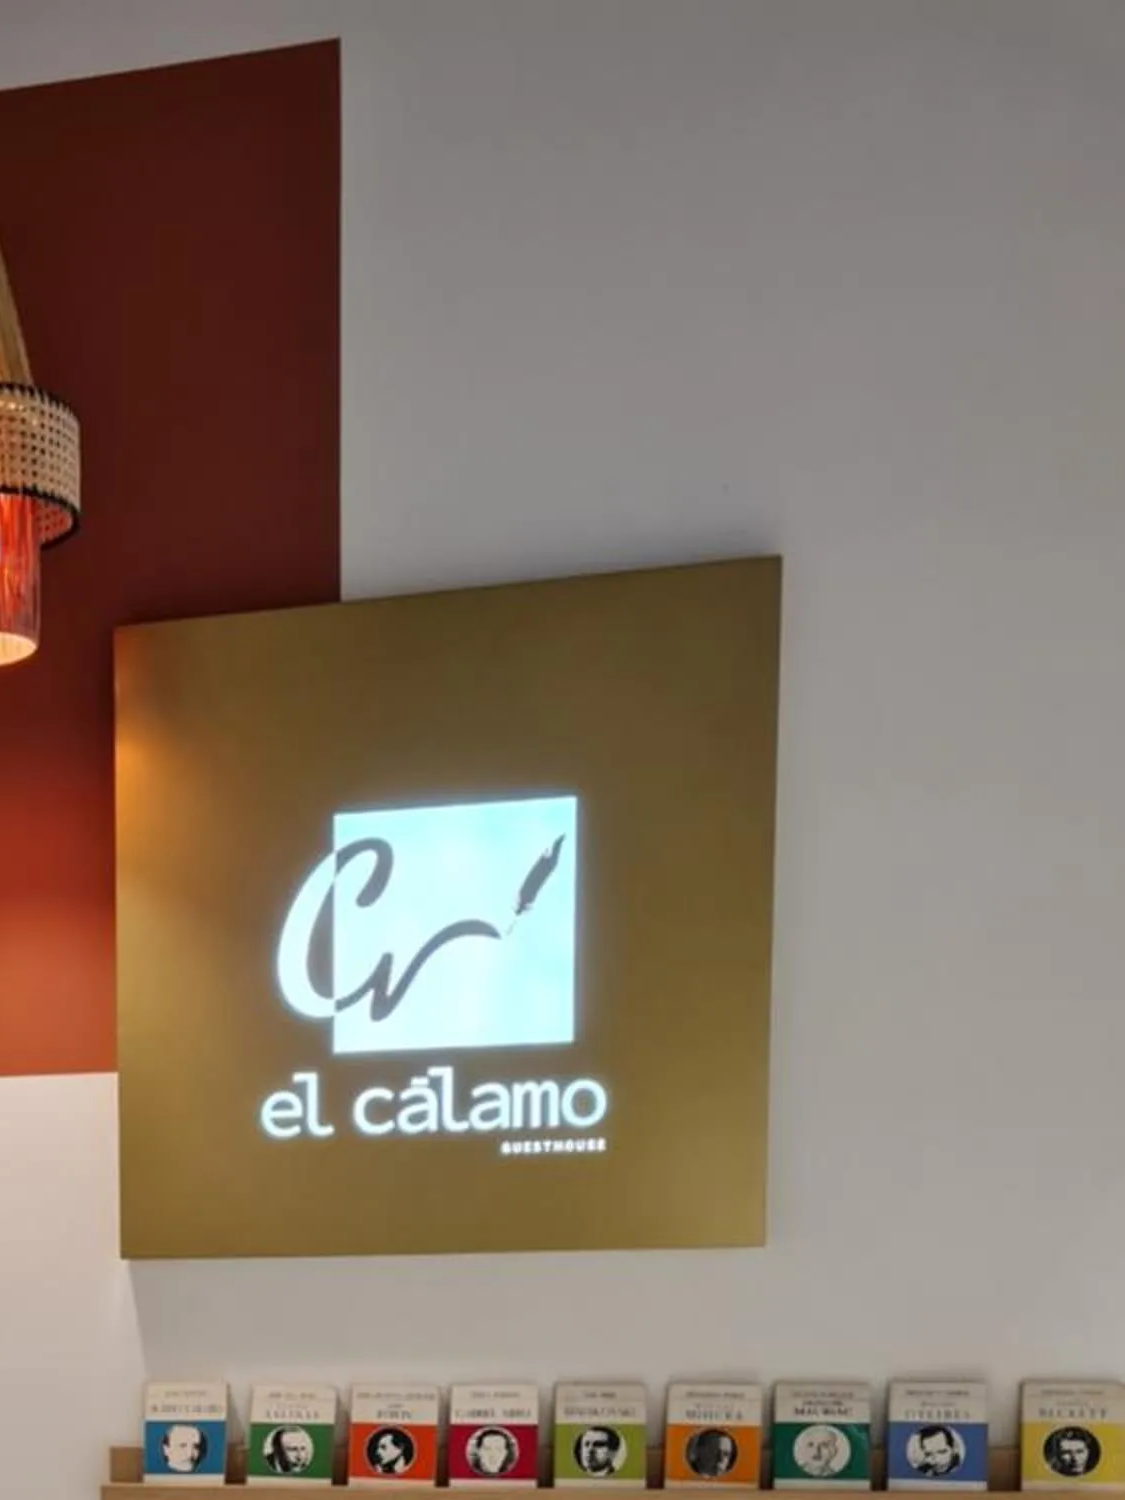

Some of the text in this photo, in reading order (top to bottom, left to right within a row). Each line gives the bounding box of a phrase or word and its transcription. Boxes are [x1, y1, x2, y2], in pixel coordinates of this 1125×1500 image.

[261, 1065, 608, 1137] el cálamo
[500, 1137, 607, 1155] GUESTHOUSE
